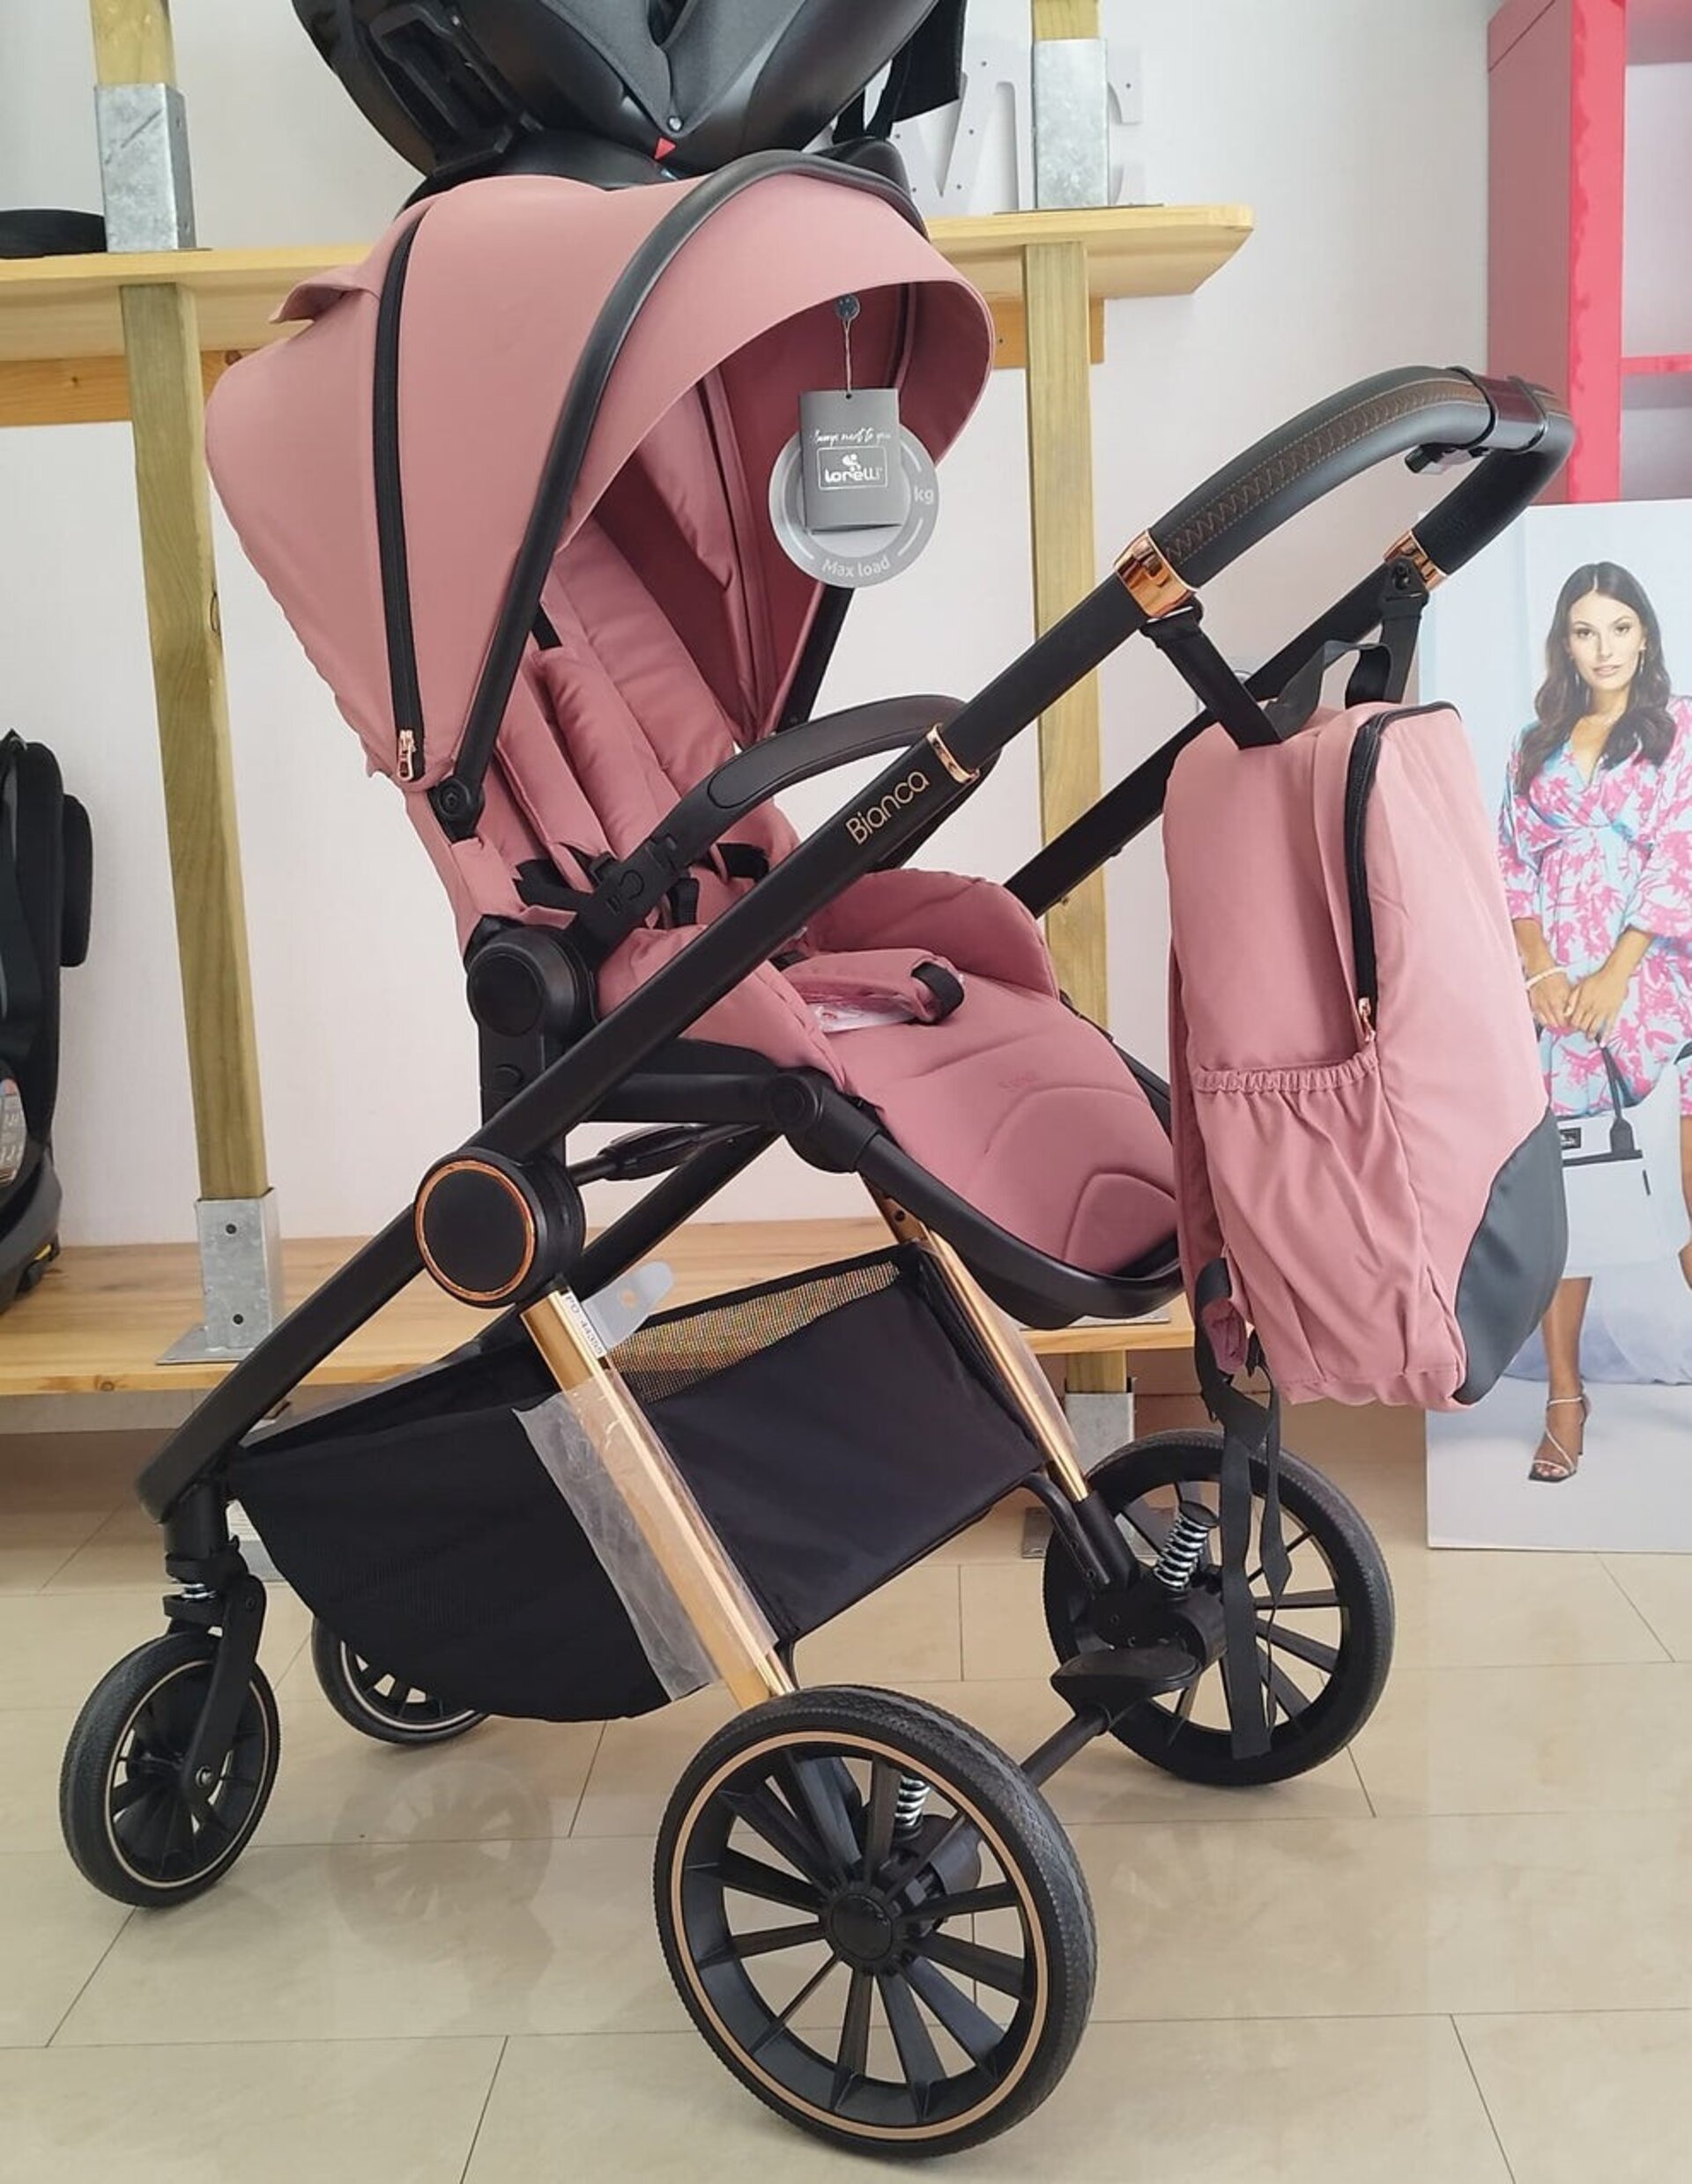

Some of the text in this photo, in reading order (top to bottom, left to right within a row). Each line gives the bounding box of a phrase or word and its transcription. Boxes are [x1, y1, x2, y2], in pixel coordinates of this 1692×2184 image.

[914, 485, 934, 505] kg
[821, 555, 889, 577] Max load
[845, 771, 931, 845] Bianca
